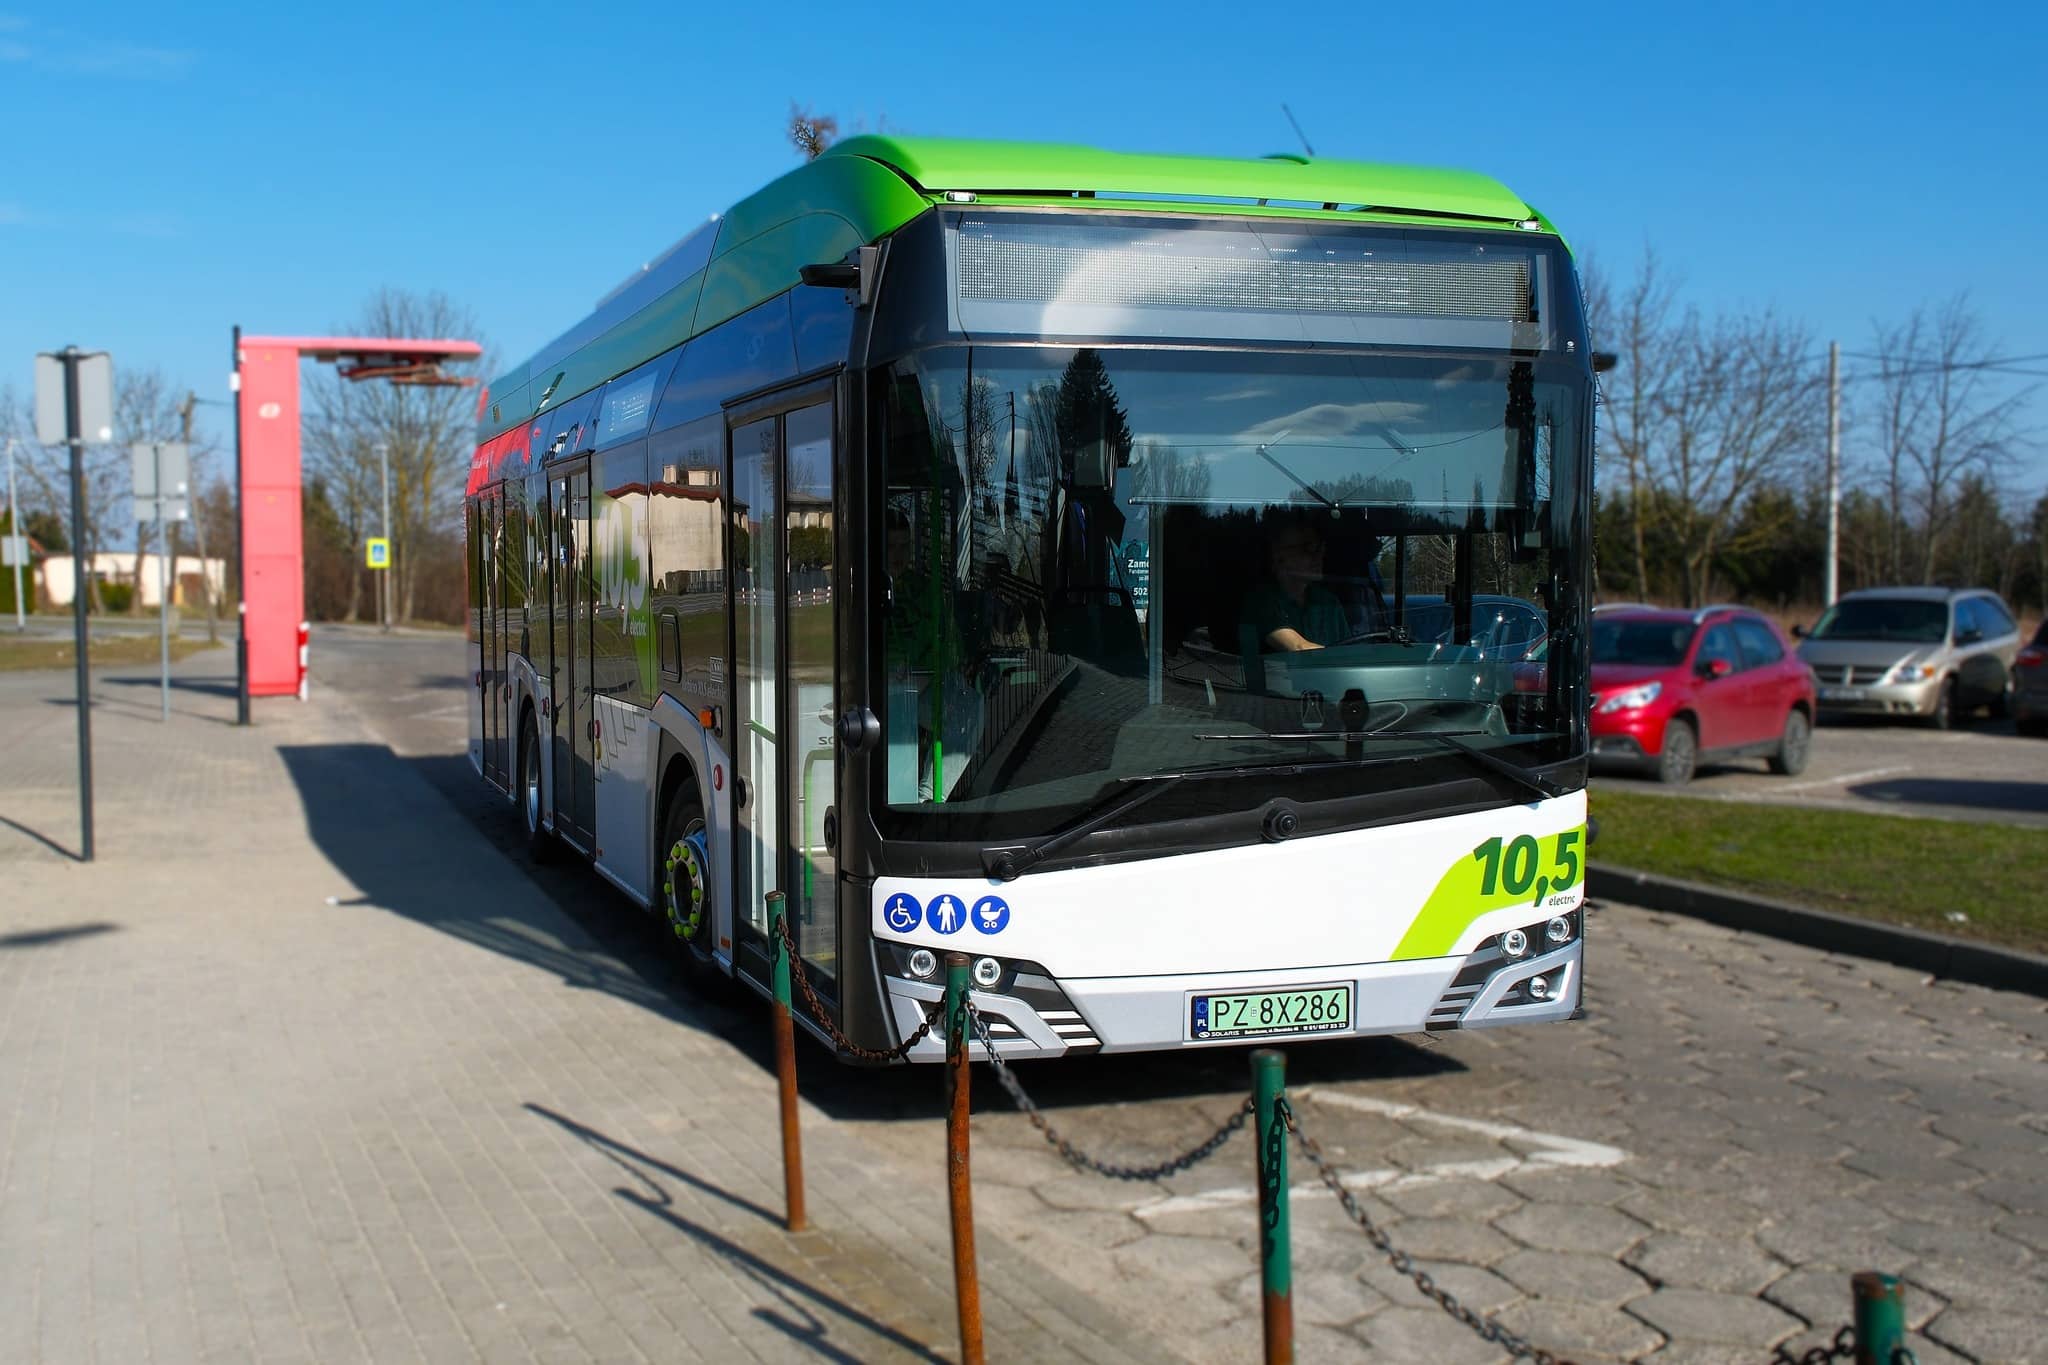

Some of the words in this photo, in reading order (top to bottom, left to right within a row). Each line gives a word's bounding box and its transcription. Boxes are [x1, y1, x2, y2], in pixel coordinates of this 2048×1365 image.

[596, 501, 649, 635] 10,5
[1133, 587, 1148, 596] 502
[1473, 831, 1579, 908] 10,5
[1548, 895, 1576, 906] electric
[1214, 999, 1249, 1028] PZ
[1260, 992, 1340, 1025] 8X286
[1197, 1018, 1207, 1027] PL
